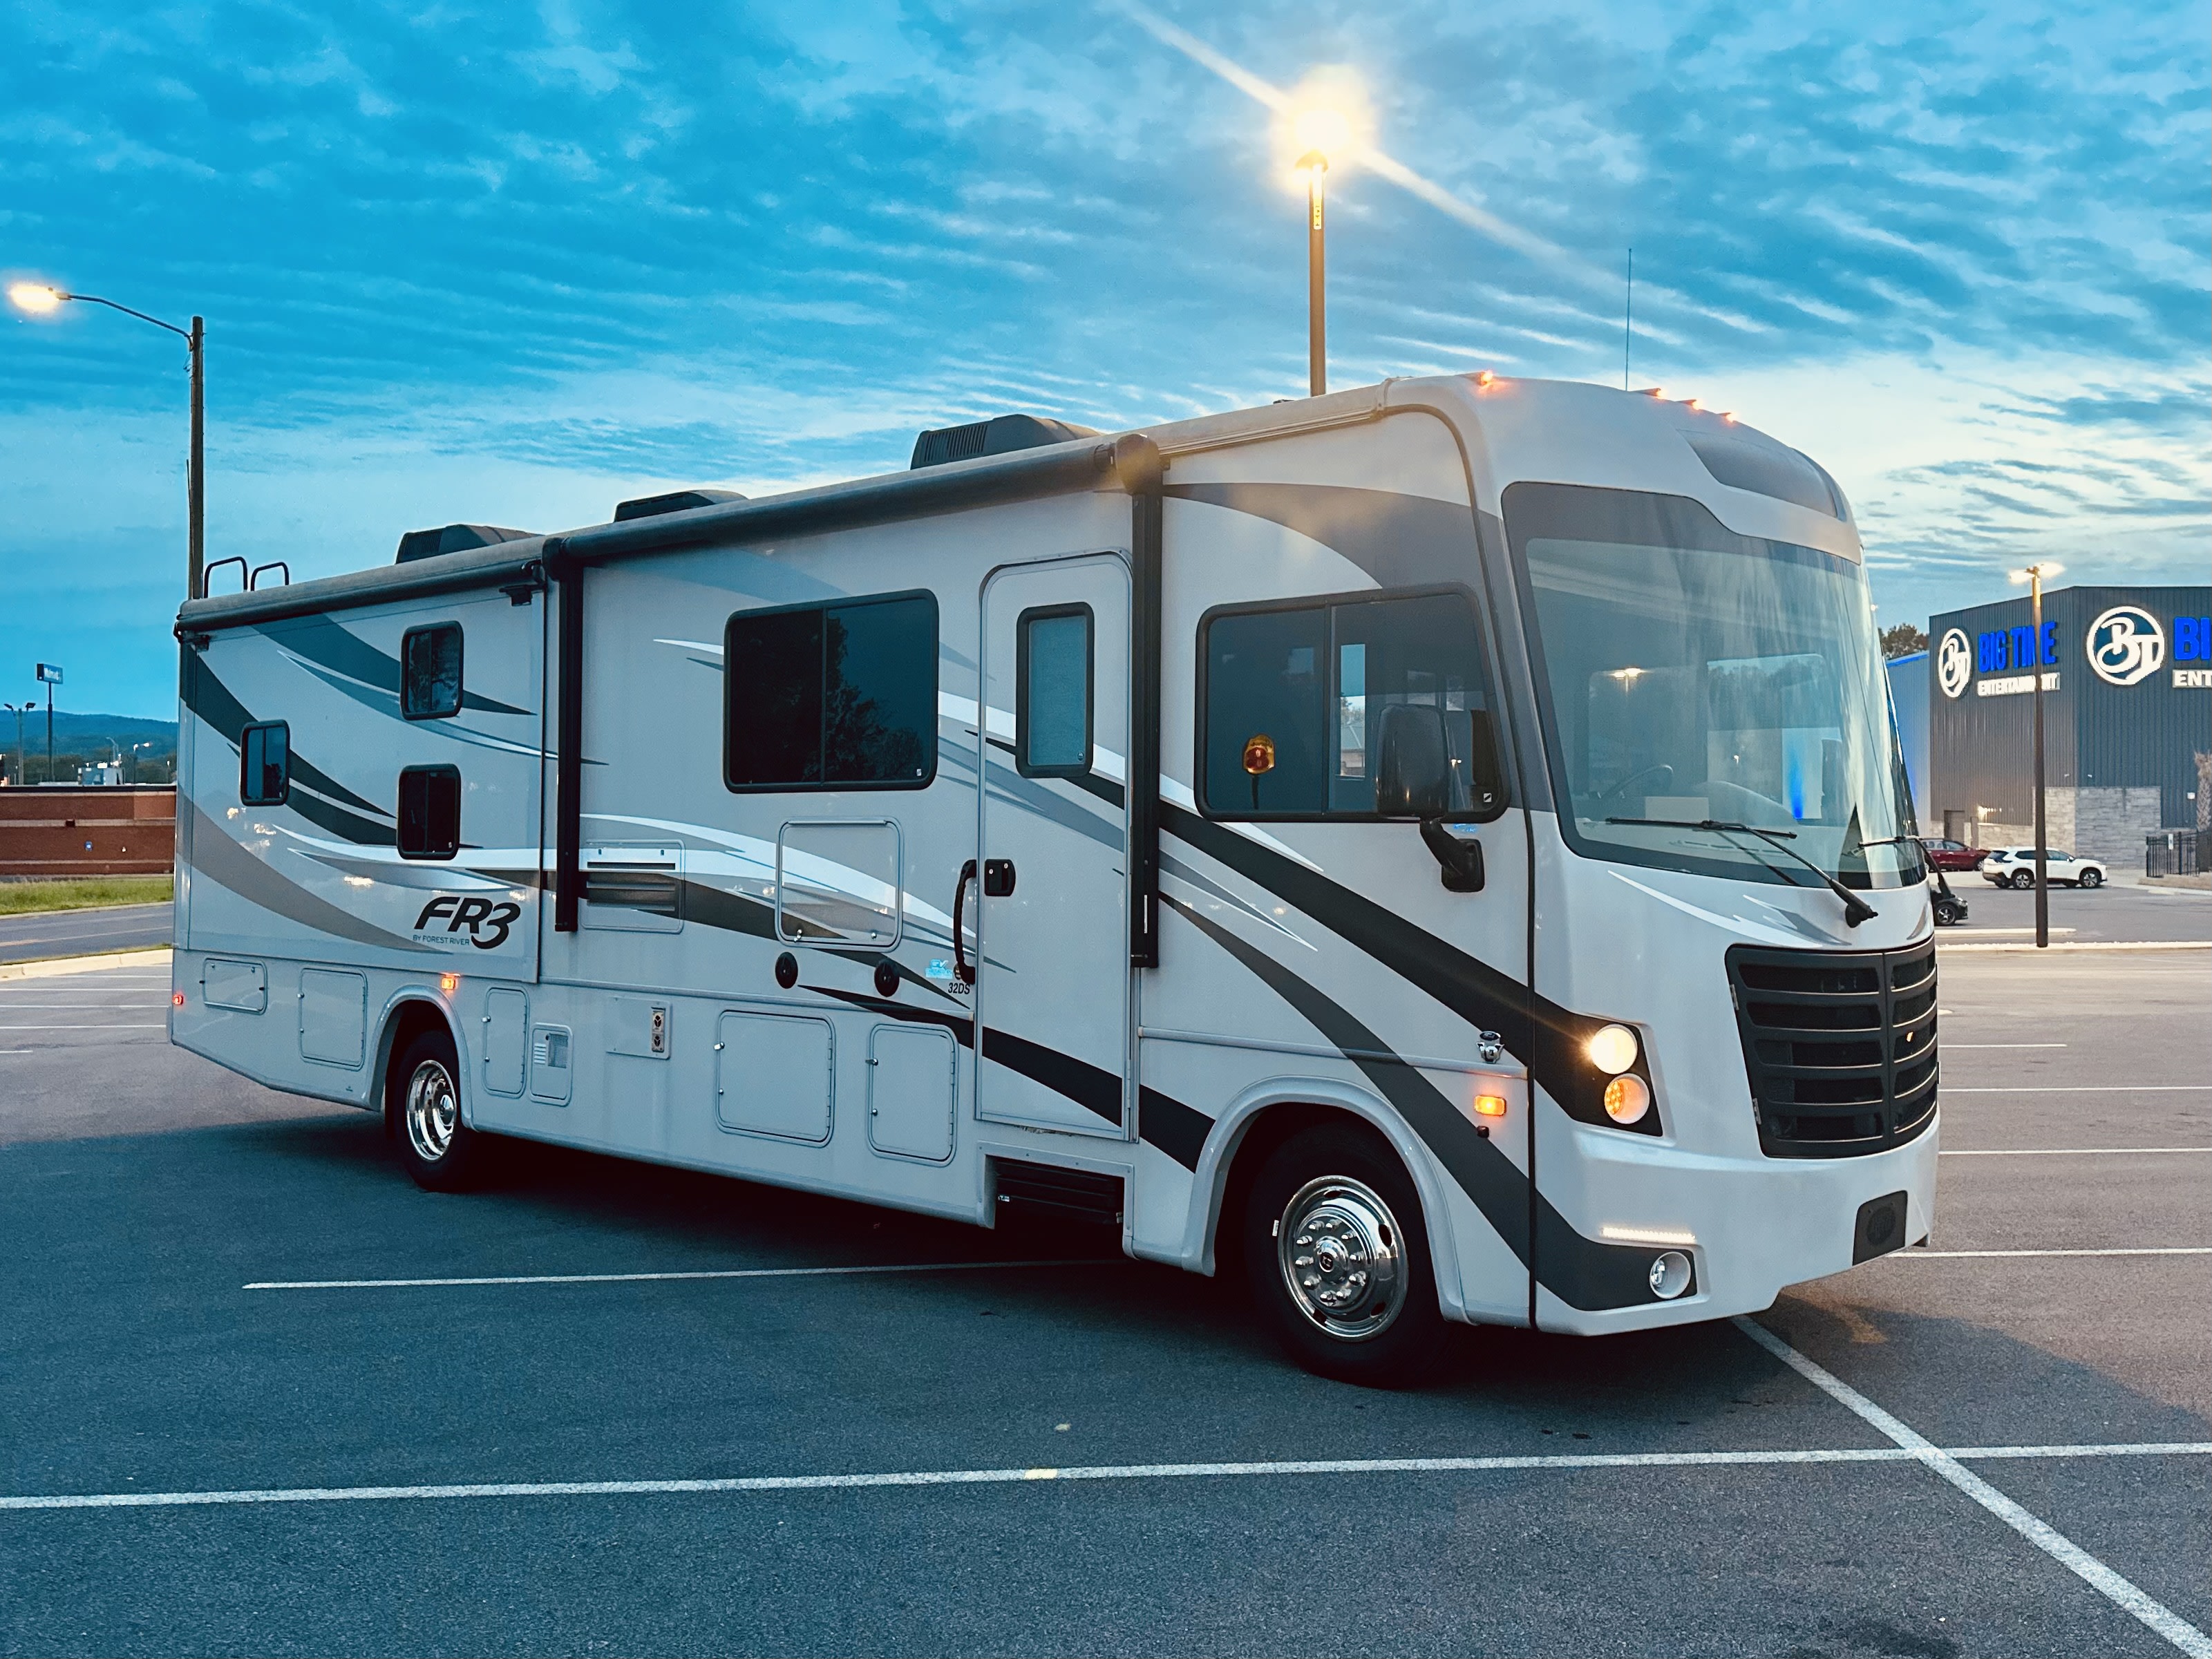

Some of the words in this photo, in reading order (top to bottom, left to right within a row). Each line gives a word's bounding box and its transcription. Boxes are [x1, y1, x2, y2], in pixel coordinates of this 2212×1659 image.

[1978, 629, 2007, 674] BIG
[414, 896, 521, 949] FR3
[948, 983, 970, 994] 32DS
